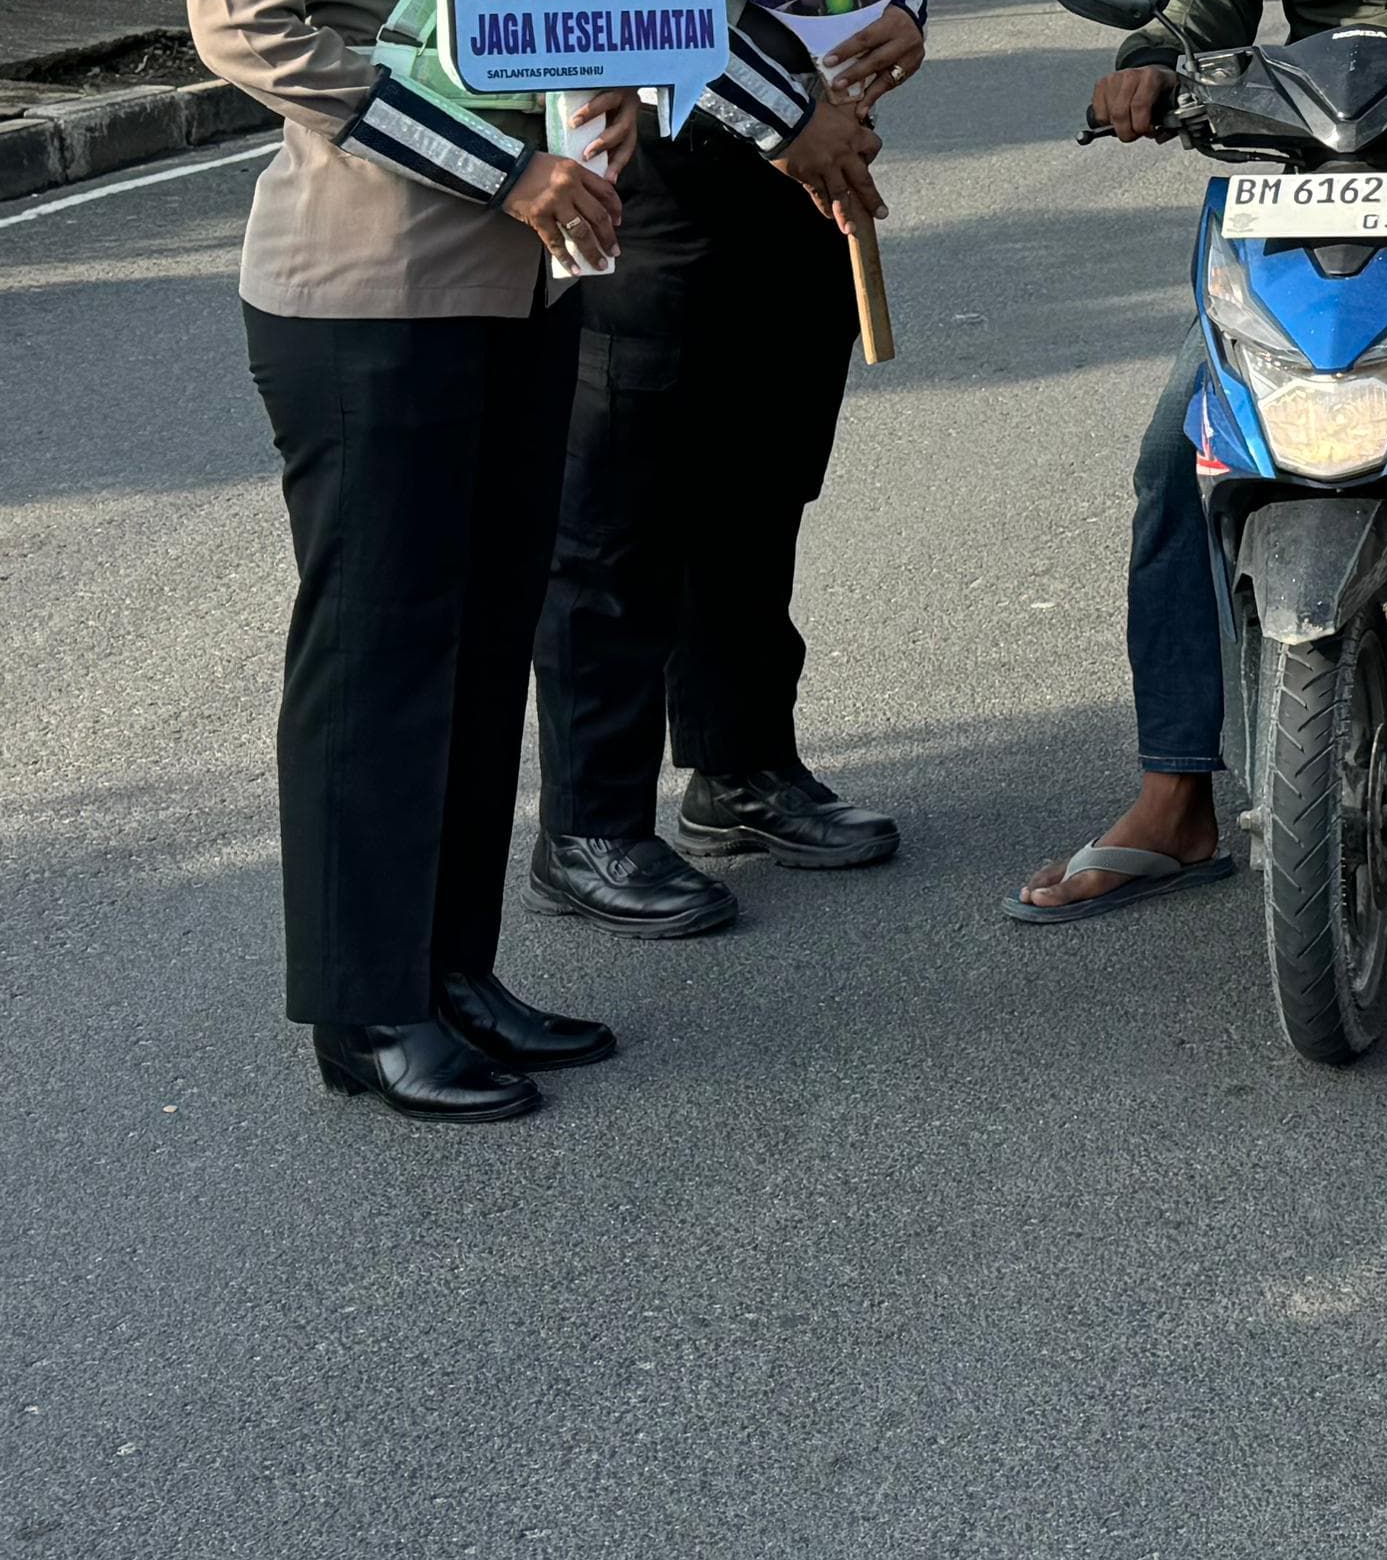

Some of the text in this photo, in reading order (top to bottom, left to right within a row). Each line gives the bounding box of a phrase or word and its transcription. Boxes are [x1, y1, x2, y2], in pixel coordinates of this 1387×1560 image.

[470, 8, 716, 57] JAGA KESELAMATAN
[487, 65, 604, 79] SATLANTAS POLRES INHU
[1235, 177, 1282, 205] BM
[1292, 176, 1384, 205] 6162
